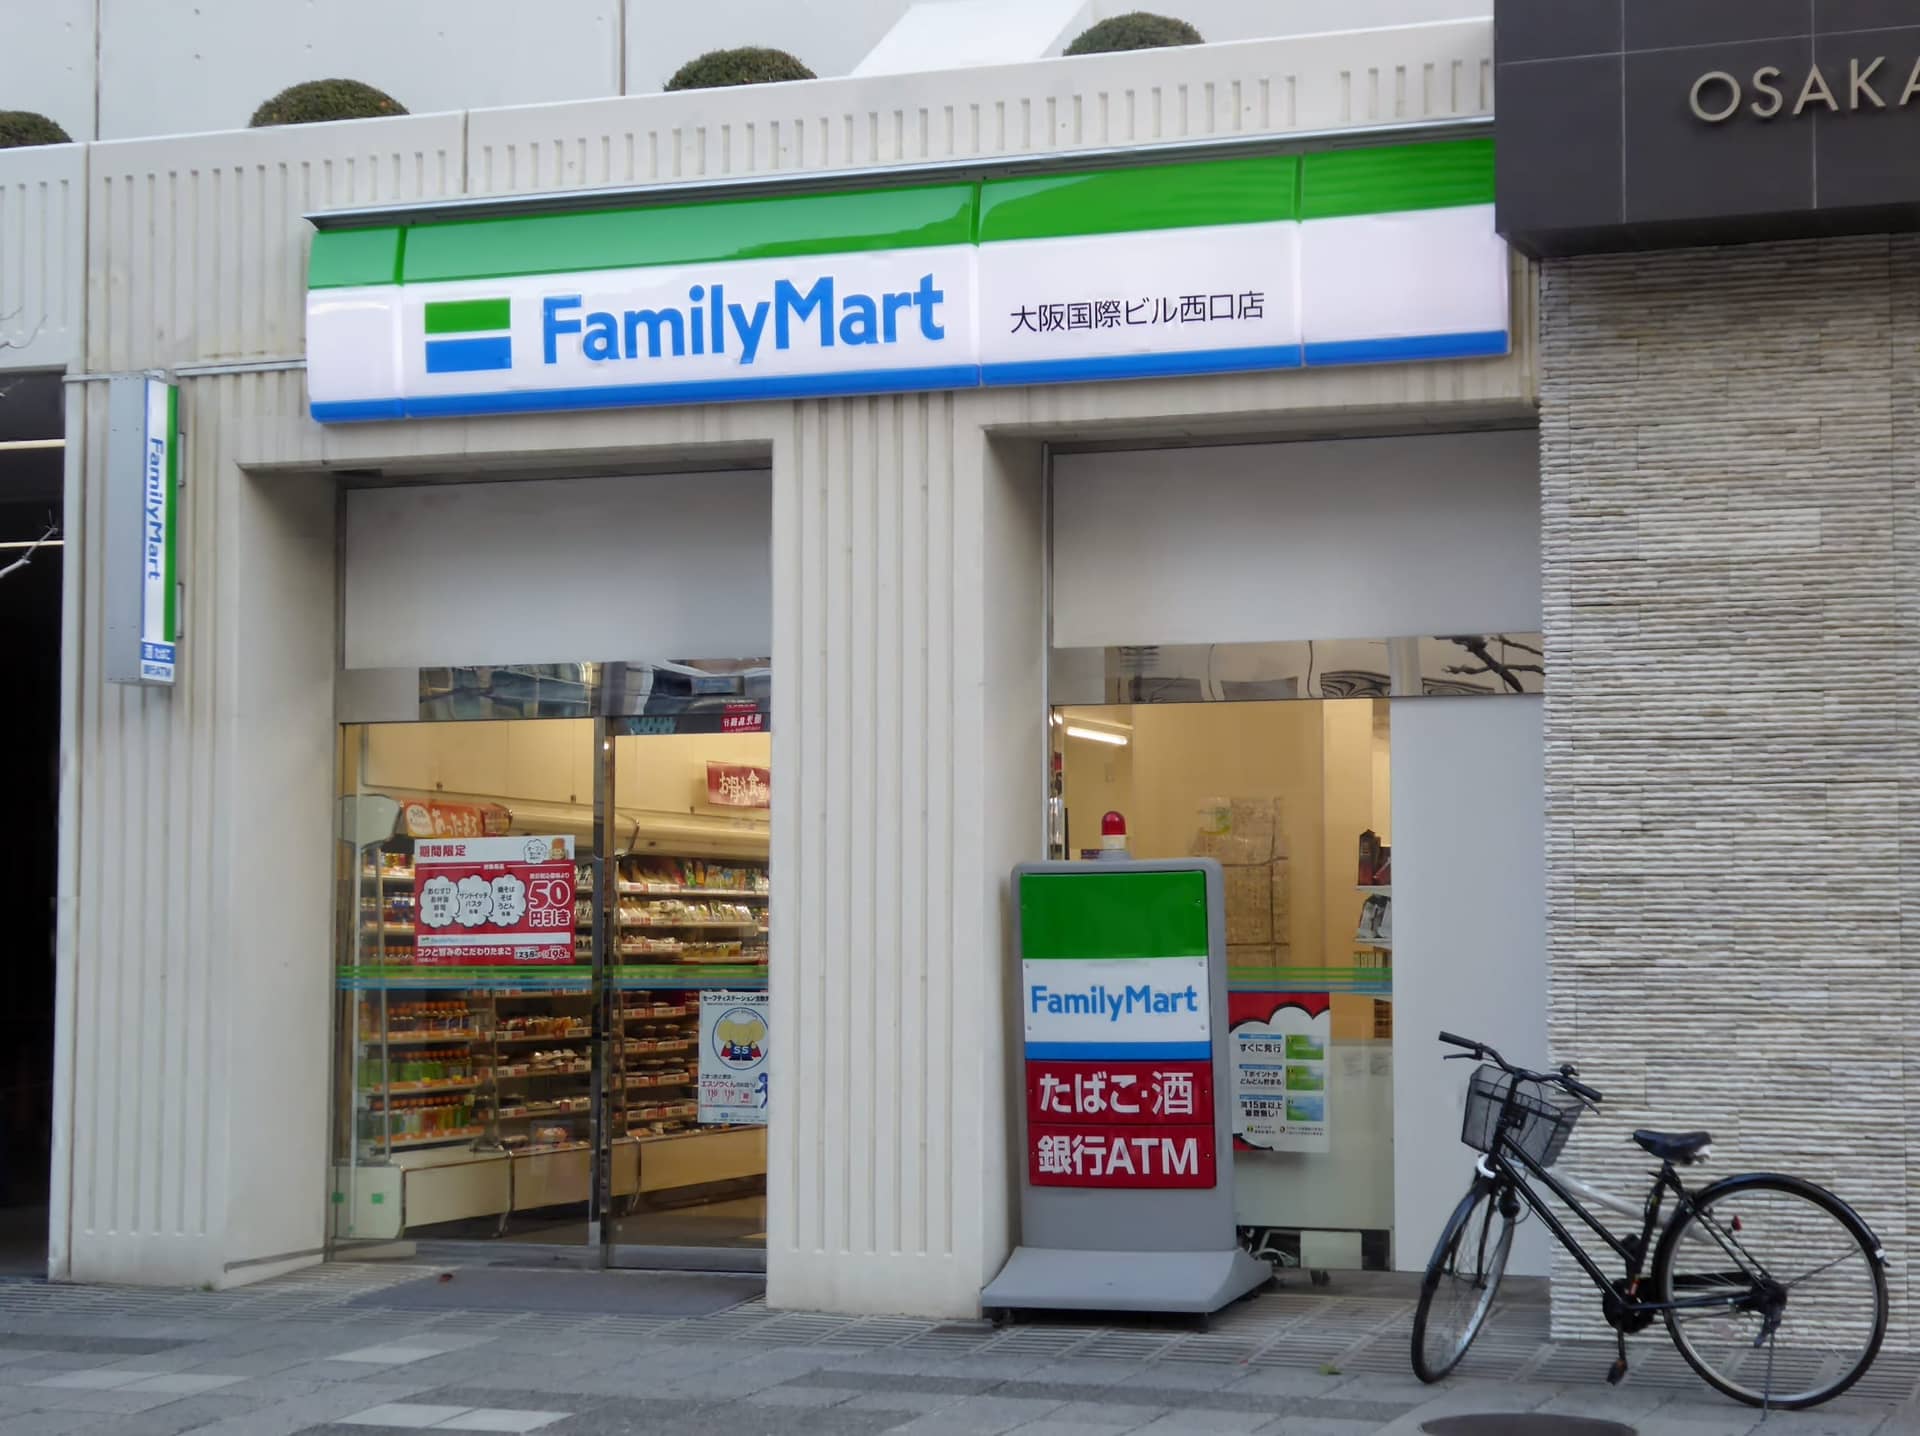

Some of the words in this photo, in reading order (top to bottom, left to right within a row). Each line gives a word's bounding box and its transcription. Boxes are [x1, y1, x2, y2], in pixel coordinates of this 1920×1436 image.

[542, 273, 945, 365] FamilyMart
[1010, 290, 1265, 333] 大阪国際ビル西口店
[146, 437, 164, 581] FamilyMart
[419, 844, 466, 857] 期間限定
[528, 879, 571, 911] 50
[529, 909, 570, 927] 円引き
[1031, 984, 1198, 1022] FamilyMart
[1039, 1070, 1194, 1116] たばこ・酒
[1037, 1134, 1199, 1176] 銀行ATM
